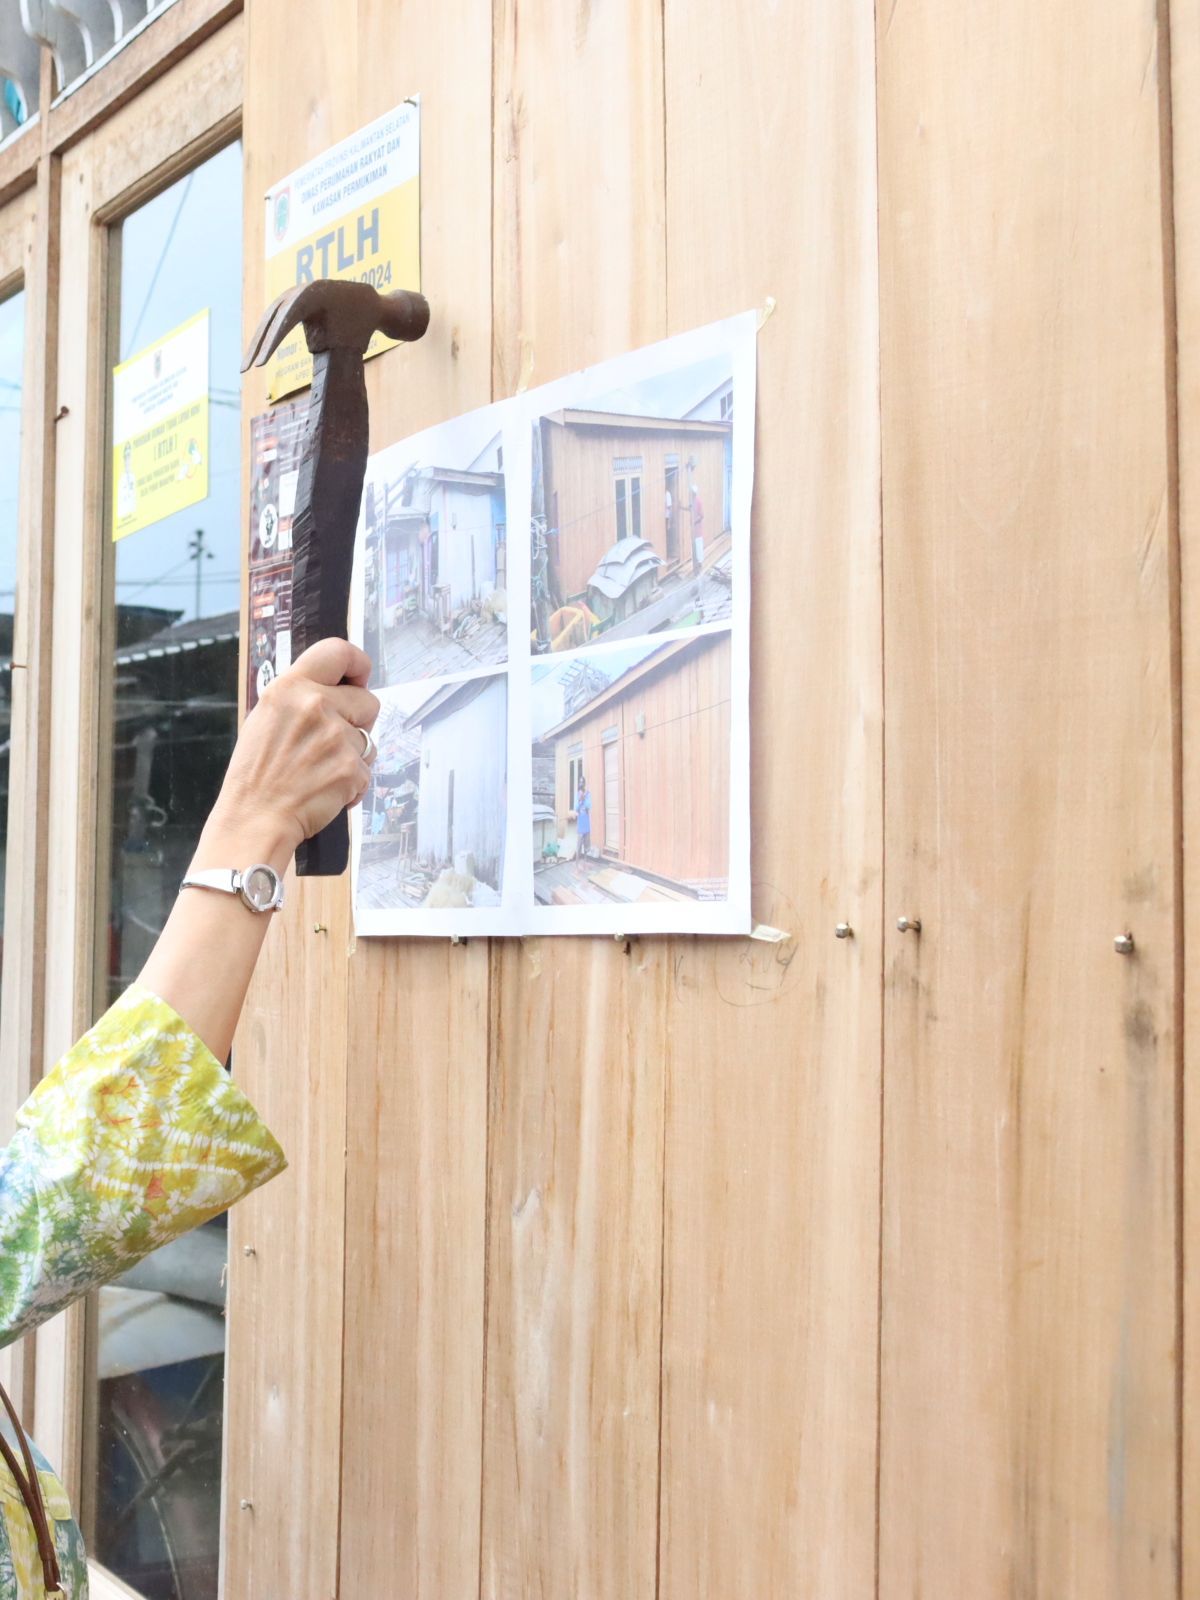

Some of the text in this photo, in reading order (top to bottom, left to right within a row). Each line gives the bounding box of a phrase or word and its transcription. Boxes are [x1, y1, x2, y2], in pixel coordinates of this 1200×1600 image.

[301, 135, 401, 205] DINAS PERUMAHAN RAKYAT DAN
[325, 149, 349, 171] PROVINSI
[350, 127, 384, 158] KALIMANTAN
[385, 112, 410, 136] SELATAN
[312, 163, 388, 216] KAWASAN PERMUKIMAN
[296, 207, 379, 285] RTLH
[277, 342, 298, 361] Nomor
